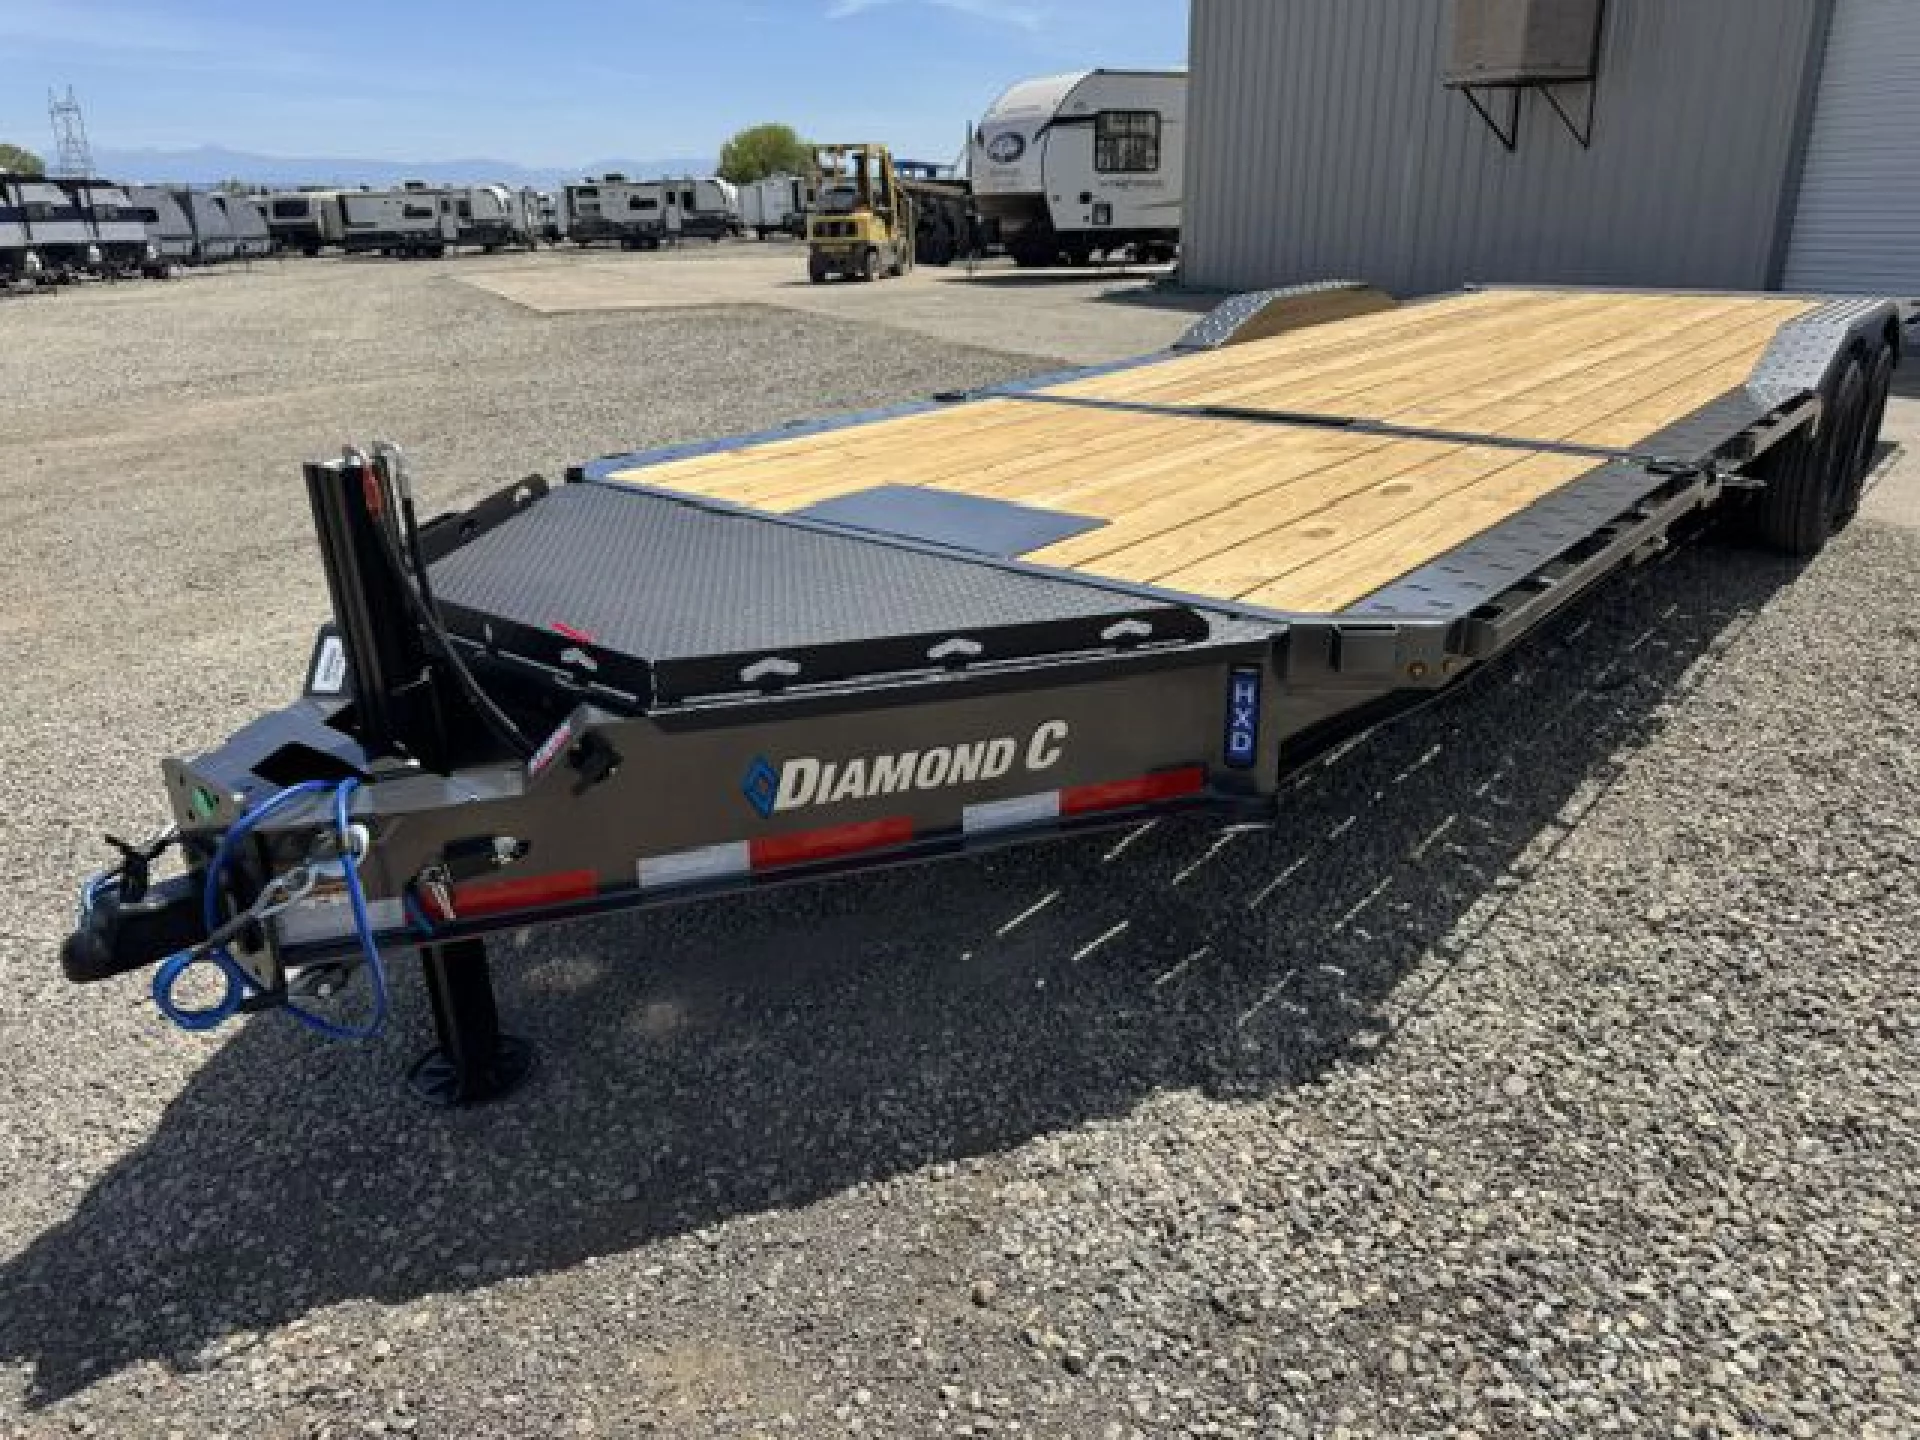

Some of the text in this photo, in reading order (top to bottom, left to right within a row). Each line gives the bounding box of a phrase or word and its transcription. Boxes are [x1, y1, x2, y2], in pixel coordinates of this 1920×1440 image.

[1233, 681, 1255, 751] HXD
[773, 719, 1069, 812] DIAMOND C
